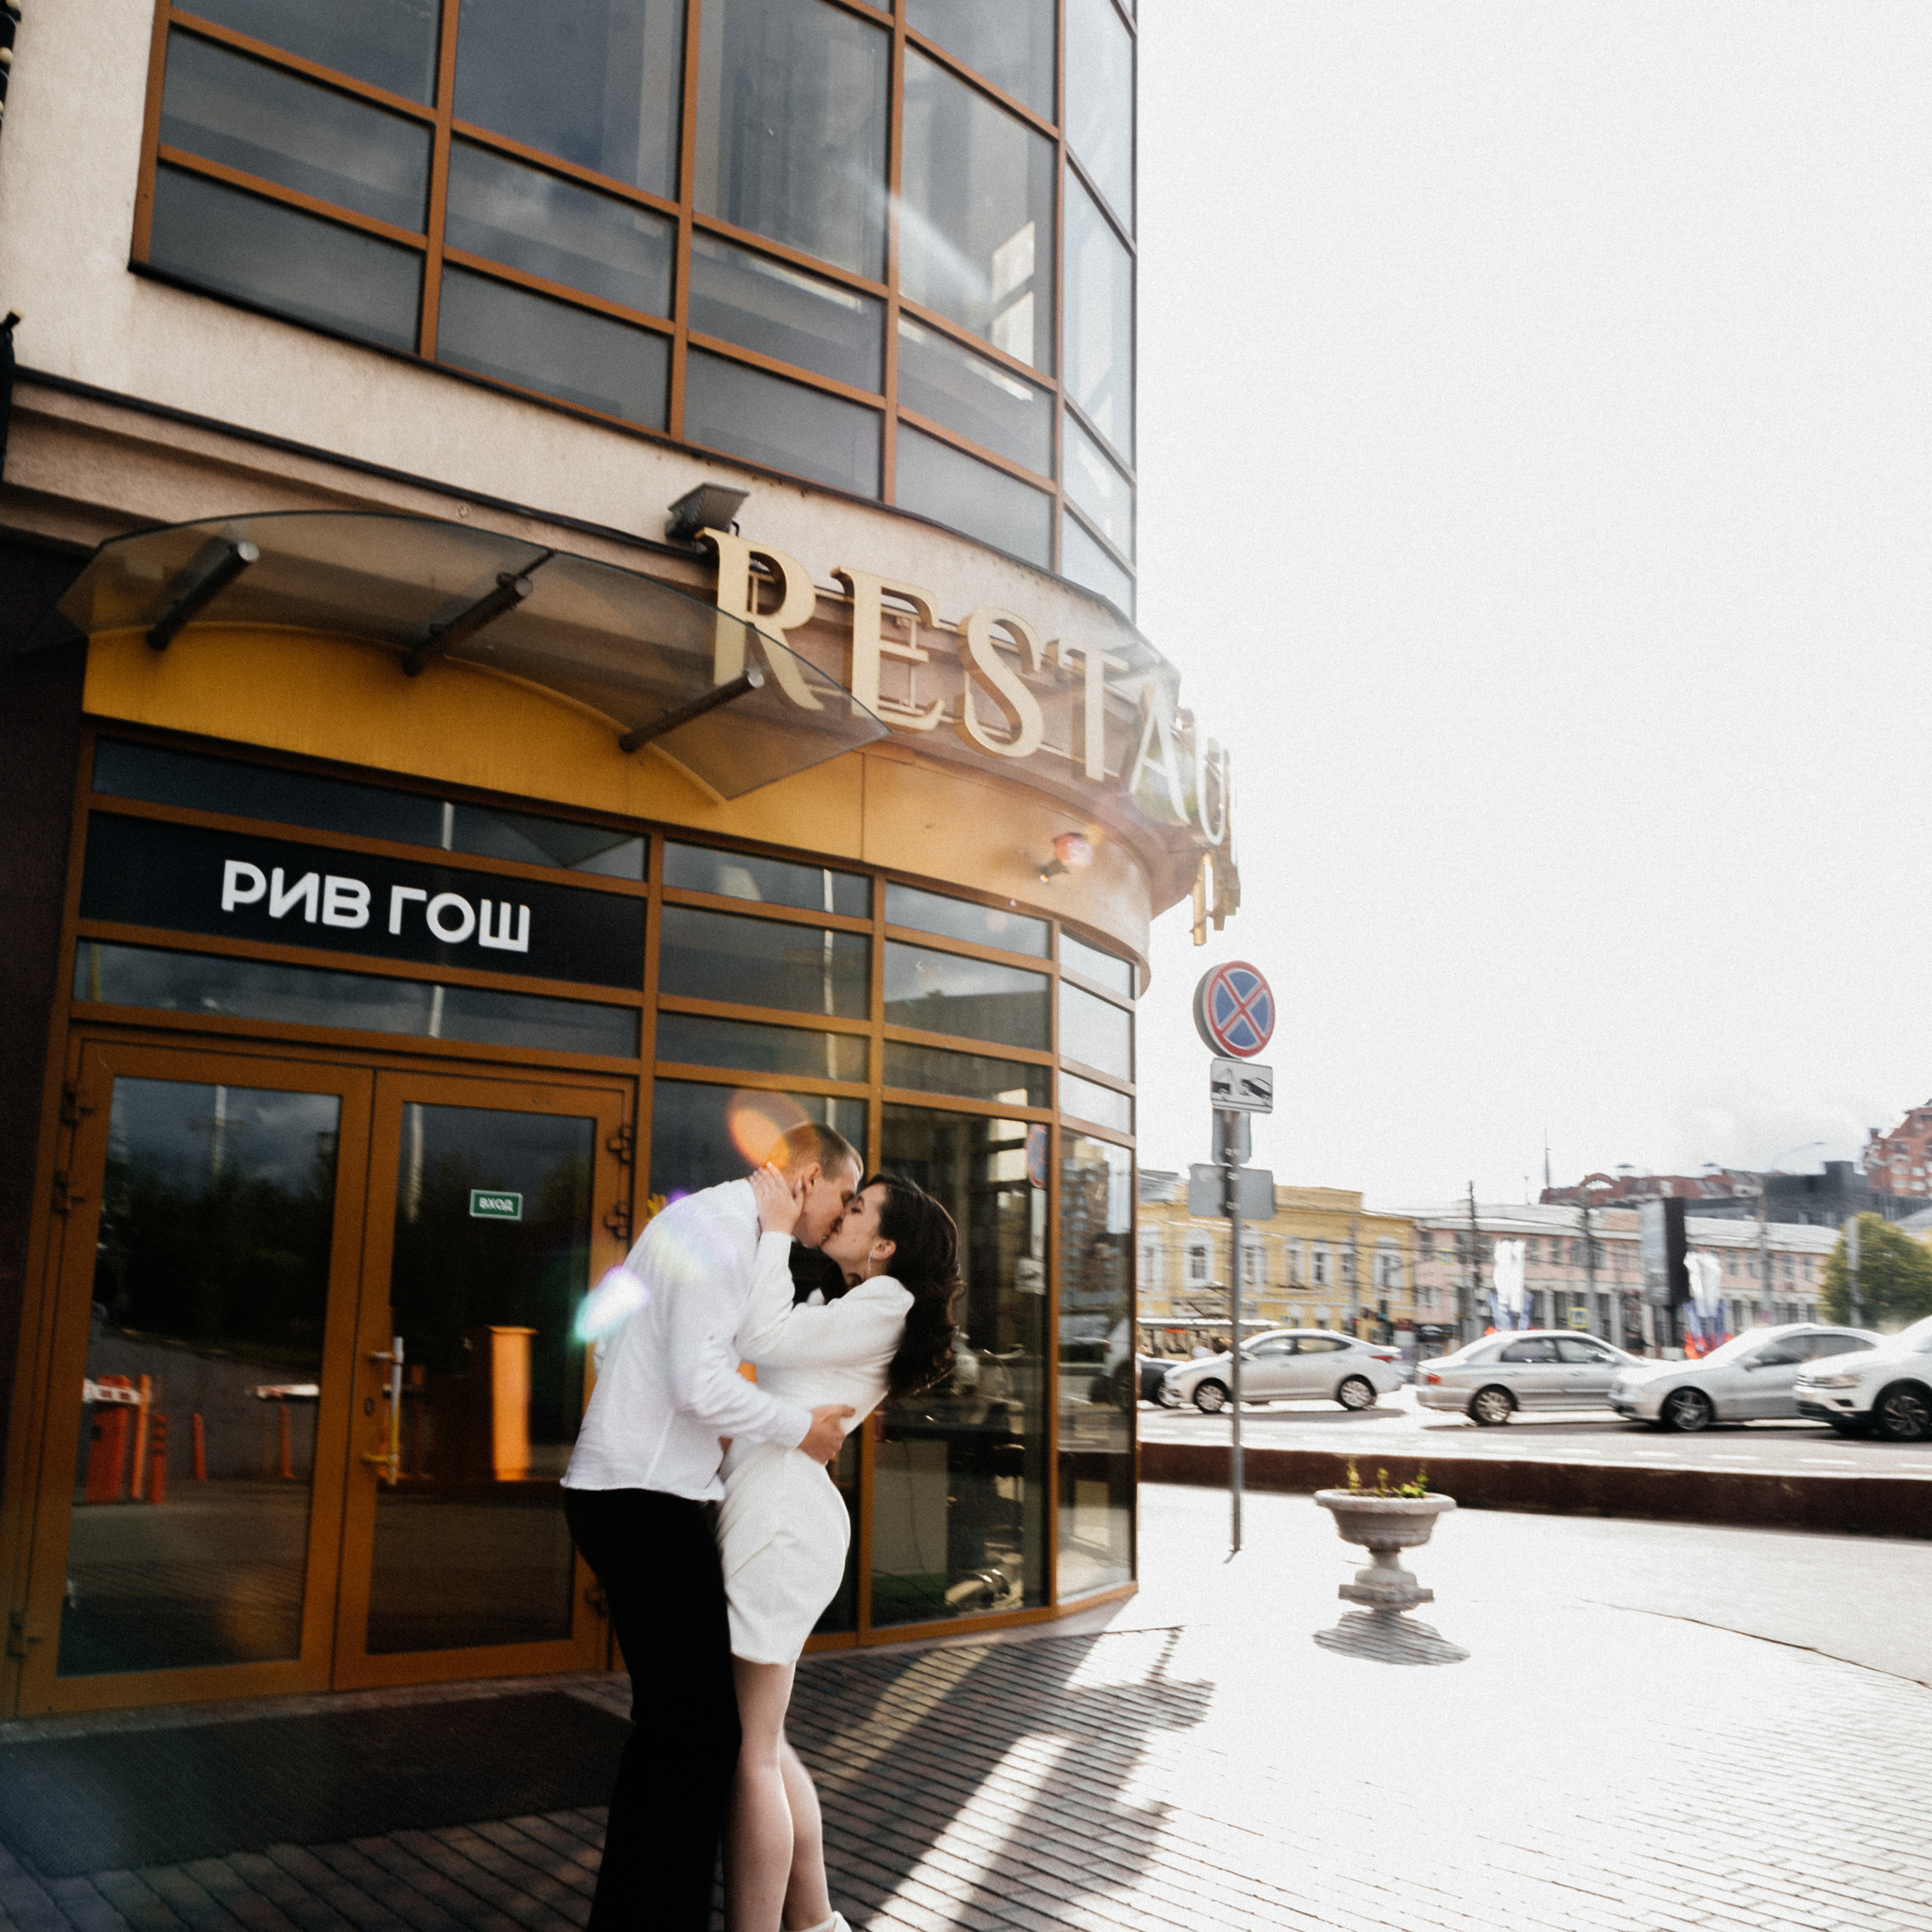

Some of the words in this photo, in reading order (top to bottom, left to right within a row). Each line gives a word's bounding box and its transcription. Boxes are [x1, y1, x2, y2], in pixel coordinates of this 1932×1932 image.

[694, 527, 1238, 865] RESTAU
[221, 859, 371, 929] РИВ
[388, 884, 531, 952] ГОШ
[478, 1197, 514, 1213] ВХОД
